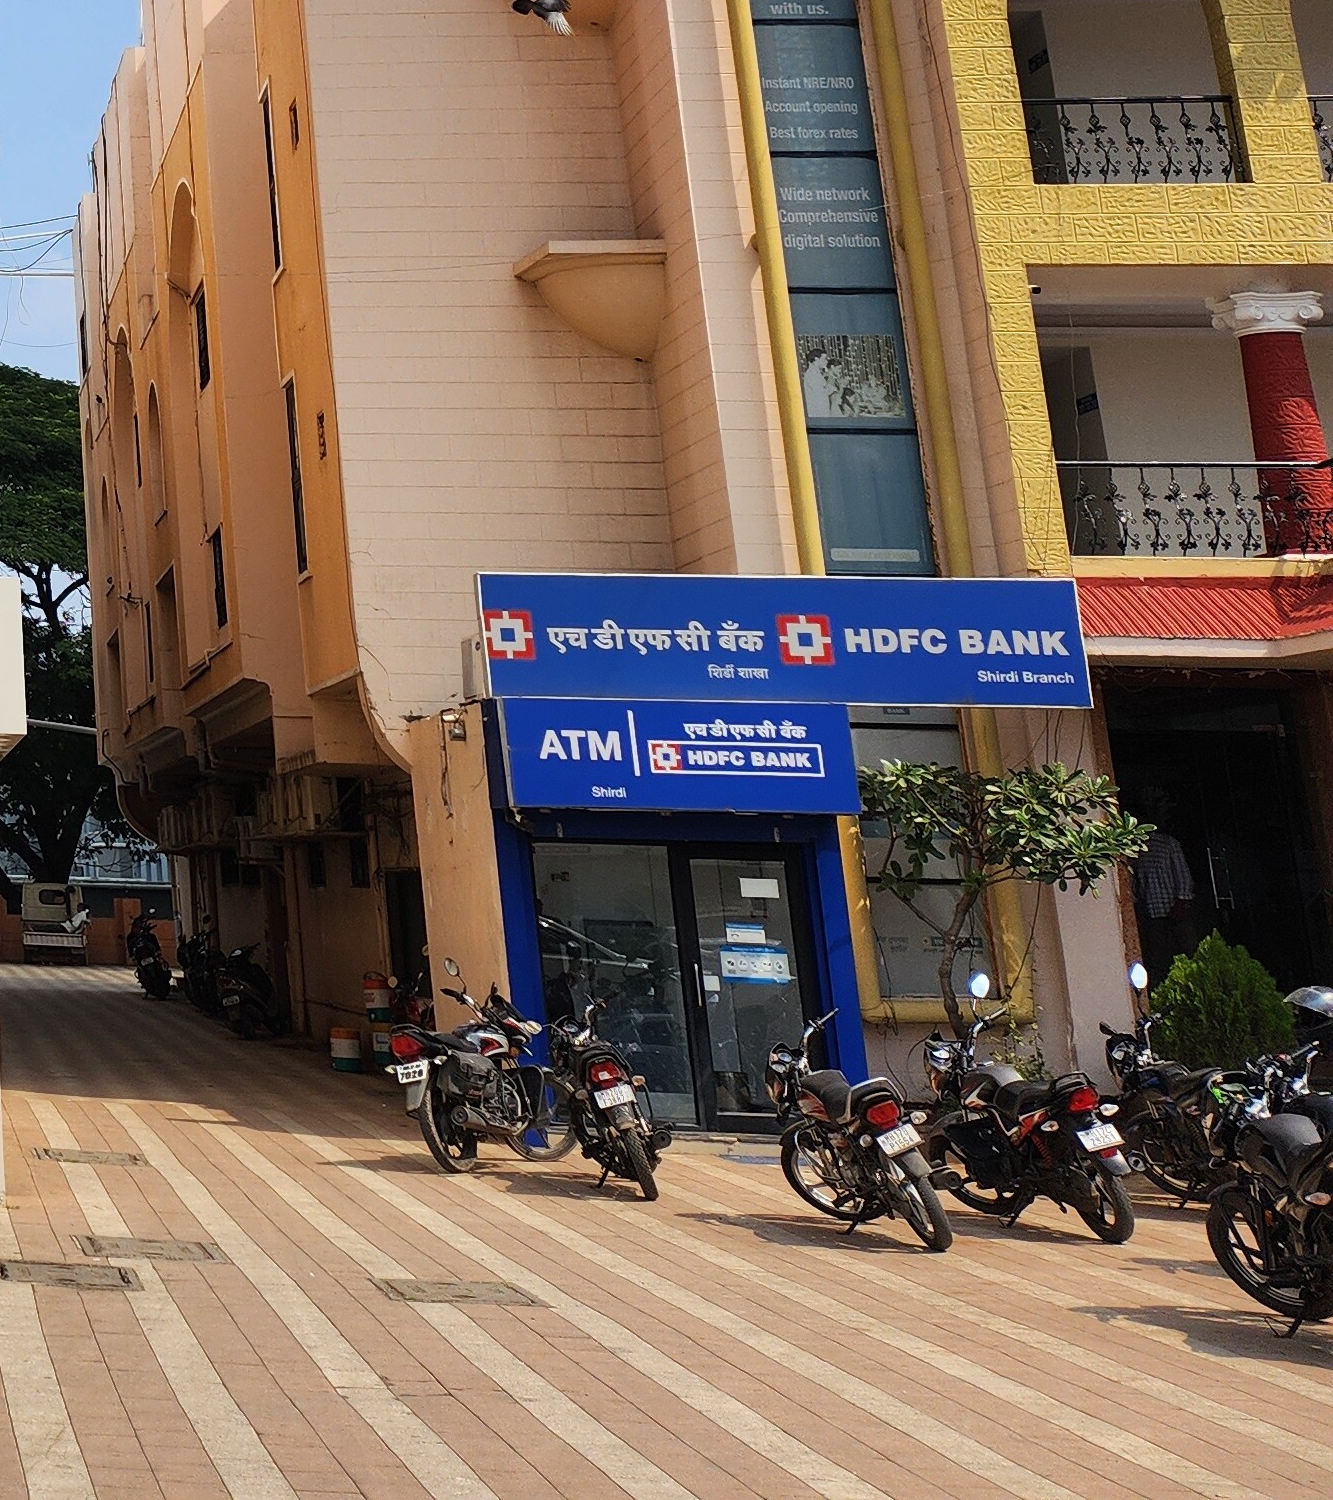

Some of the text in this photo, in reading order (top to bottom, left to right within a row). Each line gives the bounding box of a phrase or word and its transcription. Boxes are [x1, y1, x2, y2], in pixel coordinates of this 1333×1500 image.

[770, 2, 829, 15] with us.
[762, 77, 854, 89] Instant NRE/NRO
[765, 100, 858, 115] Account opening
[769, 126, 859, 139] Best forex rates
[779, 187, 871, 201] Wide network
[779, 209, 879, 226] Comprehensive
[784, 233, 881, 250] digital solution
[844, 628, 1071, 657] HDFC BANK
[737, 667, 770, 680] शाखा
[977, 670, 1075, 684] Shirdi Branch
[539, 729, 623, 761] ATM
[687, 750, 813, 768] HDFC BANK
[591, 785, 627, 798] Shirdi
